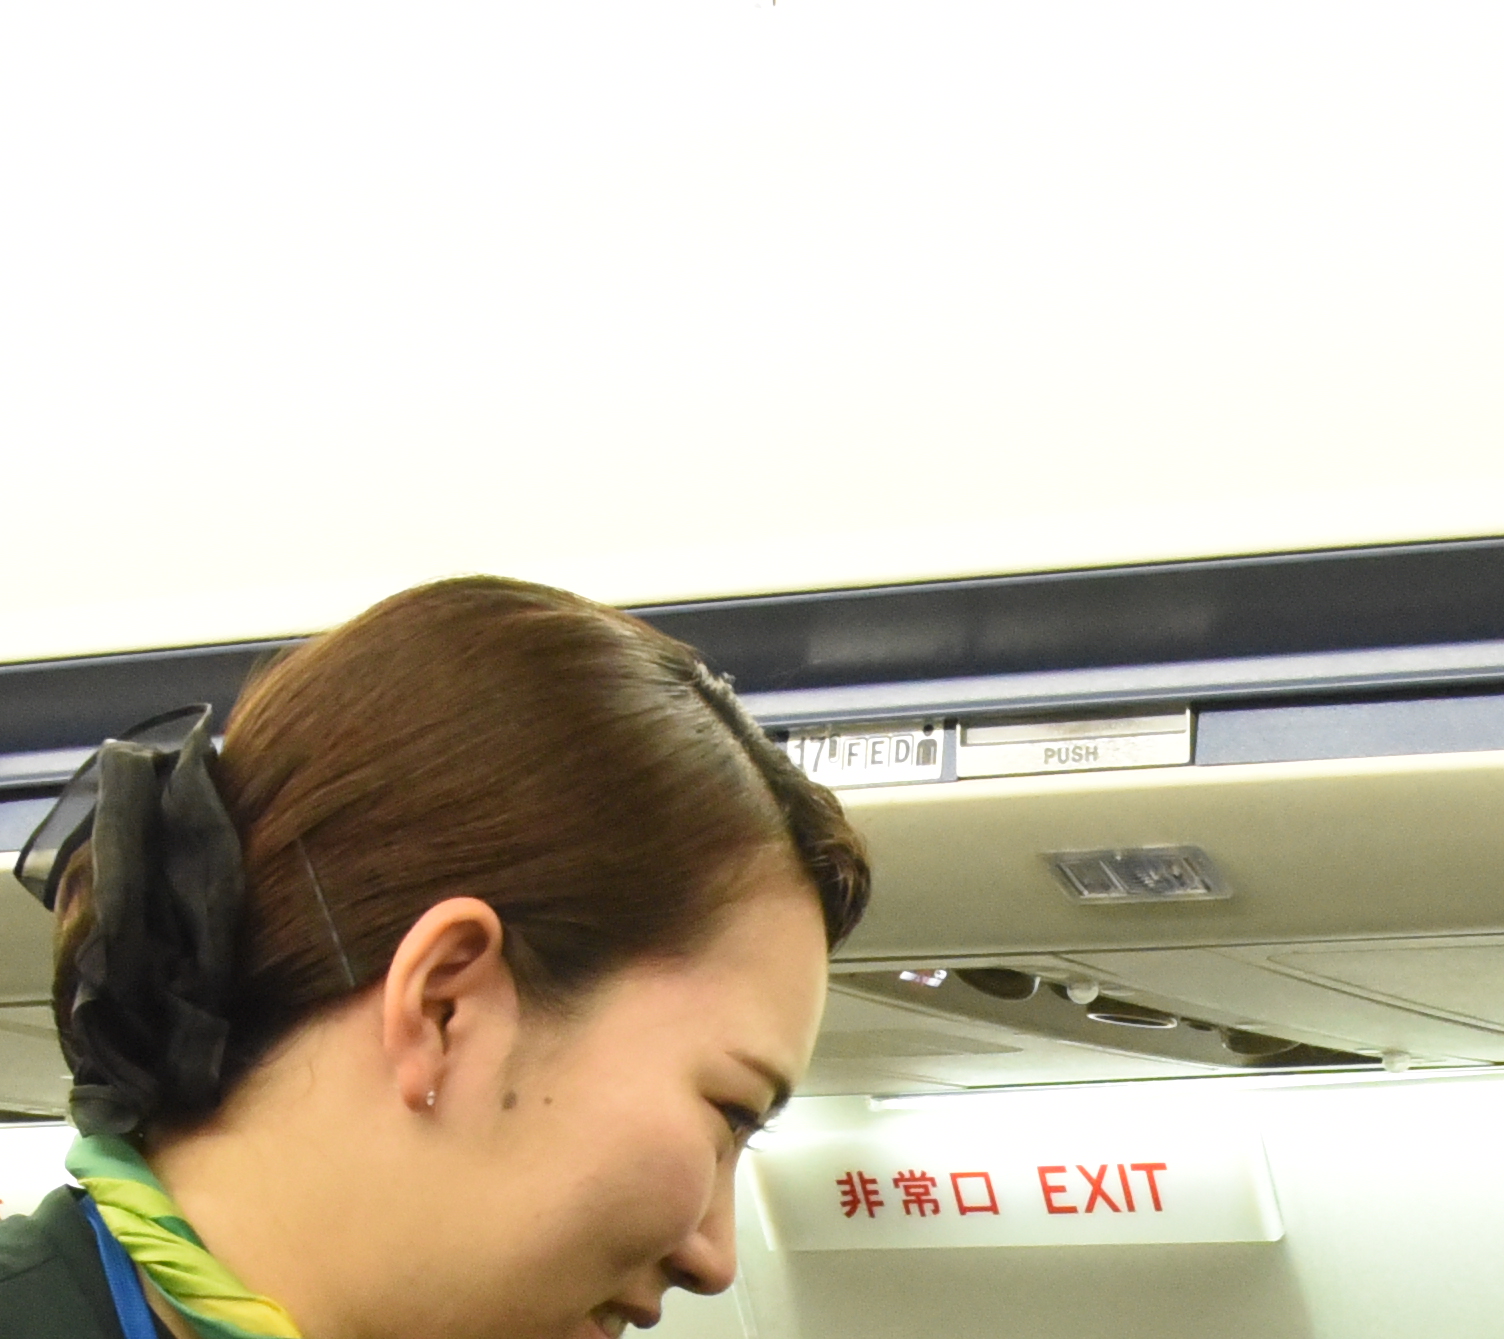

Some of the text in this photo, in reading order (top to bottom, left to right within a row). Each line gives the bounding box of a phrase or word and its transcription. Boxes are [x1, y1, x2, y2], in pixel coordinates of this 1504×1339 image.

[1043, 745, 1099, 765] PUSH
[835, 1162, 1168, 1219] 非常口 EXIT
